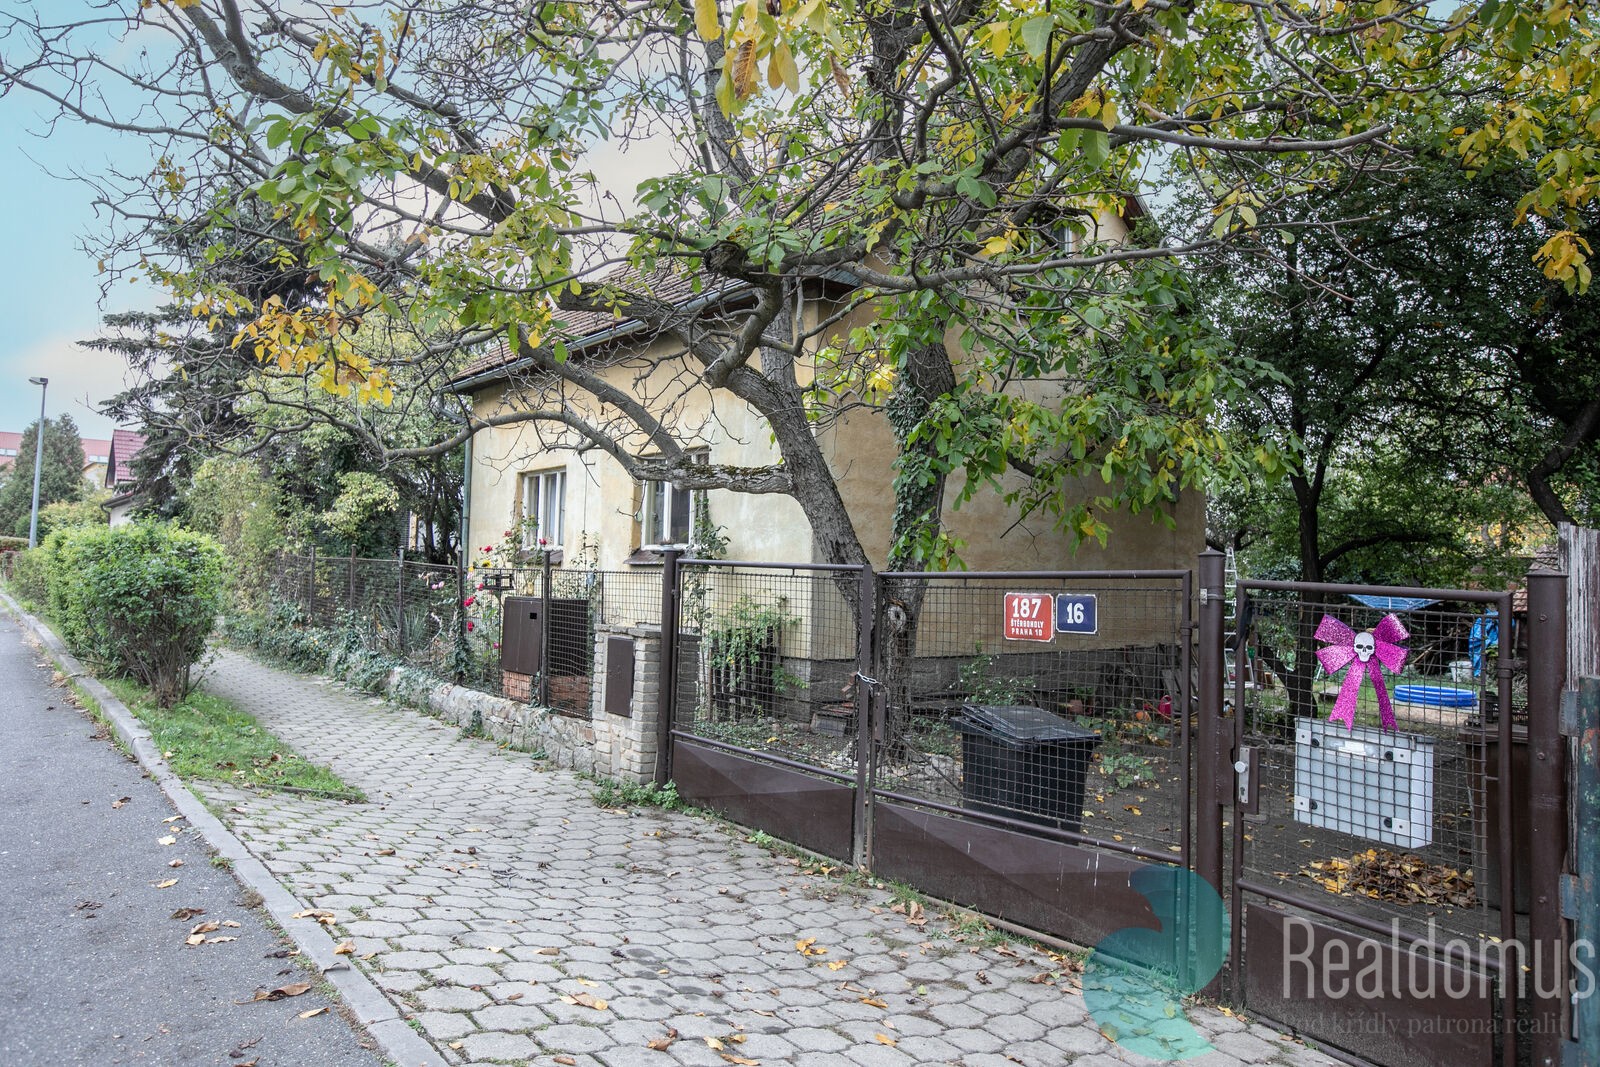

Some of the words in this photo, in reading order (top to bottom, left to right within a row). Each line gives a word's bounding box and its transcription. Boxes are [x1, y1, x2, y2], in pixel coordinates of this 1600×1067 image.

[1012, 597, 1042, 619] 187
[1066, 602, 1085, 624] 16
[1011, 627, 1033, 636] PRAHA
[1035, 628, 1043, 637] 10
